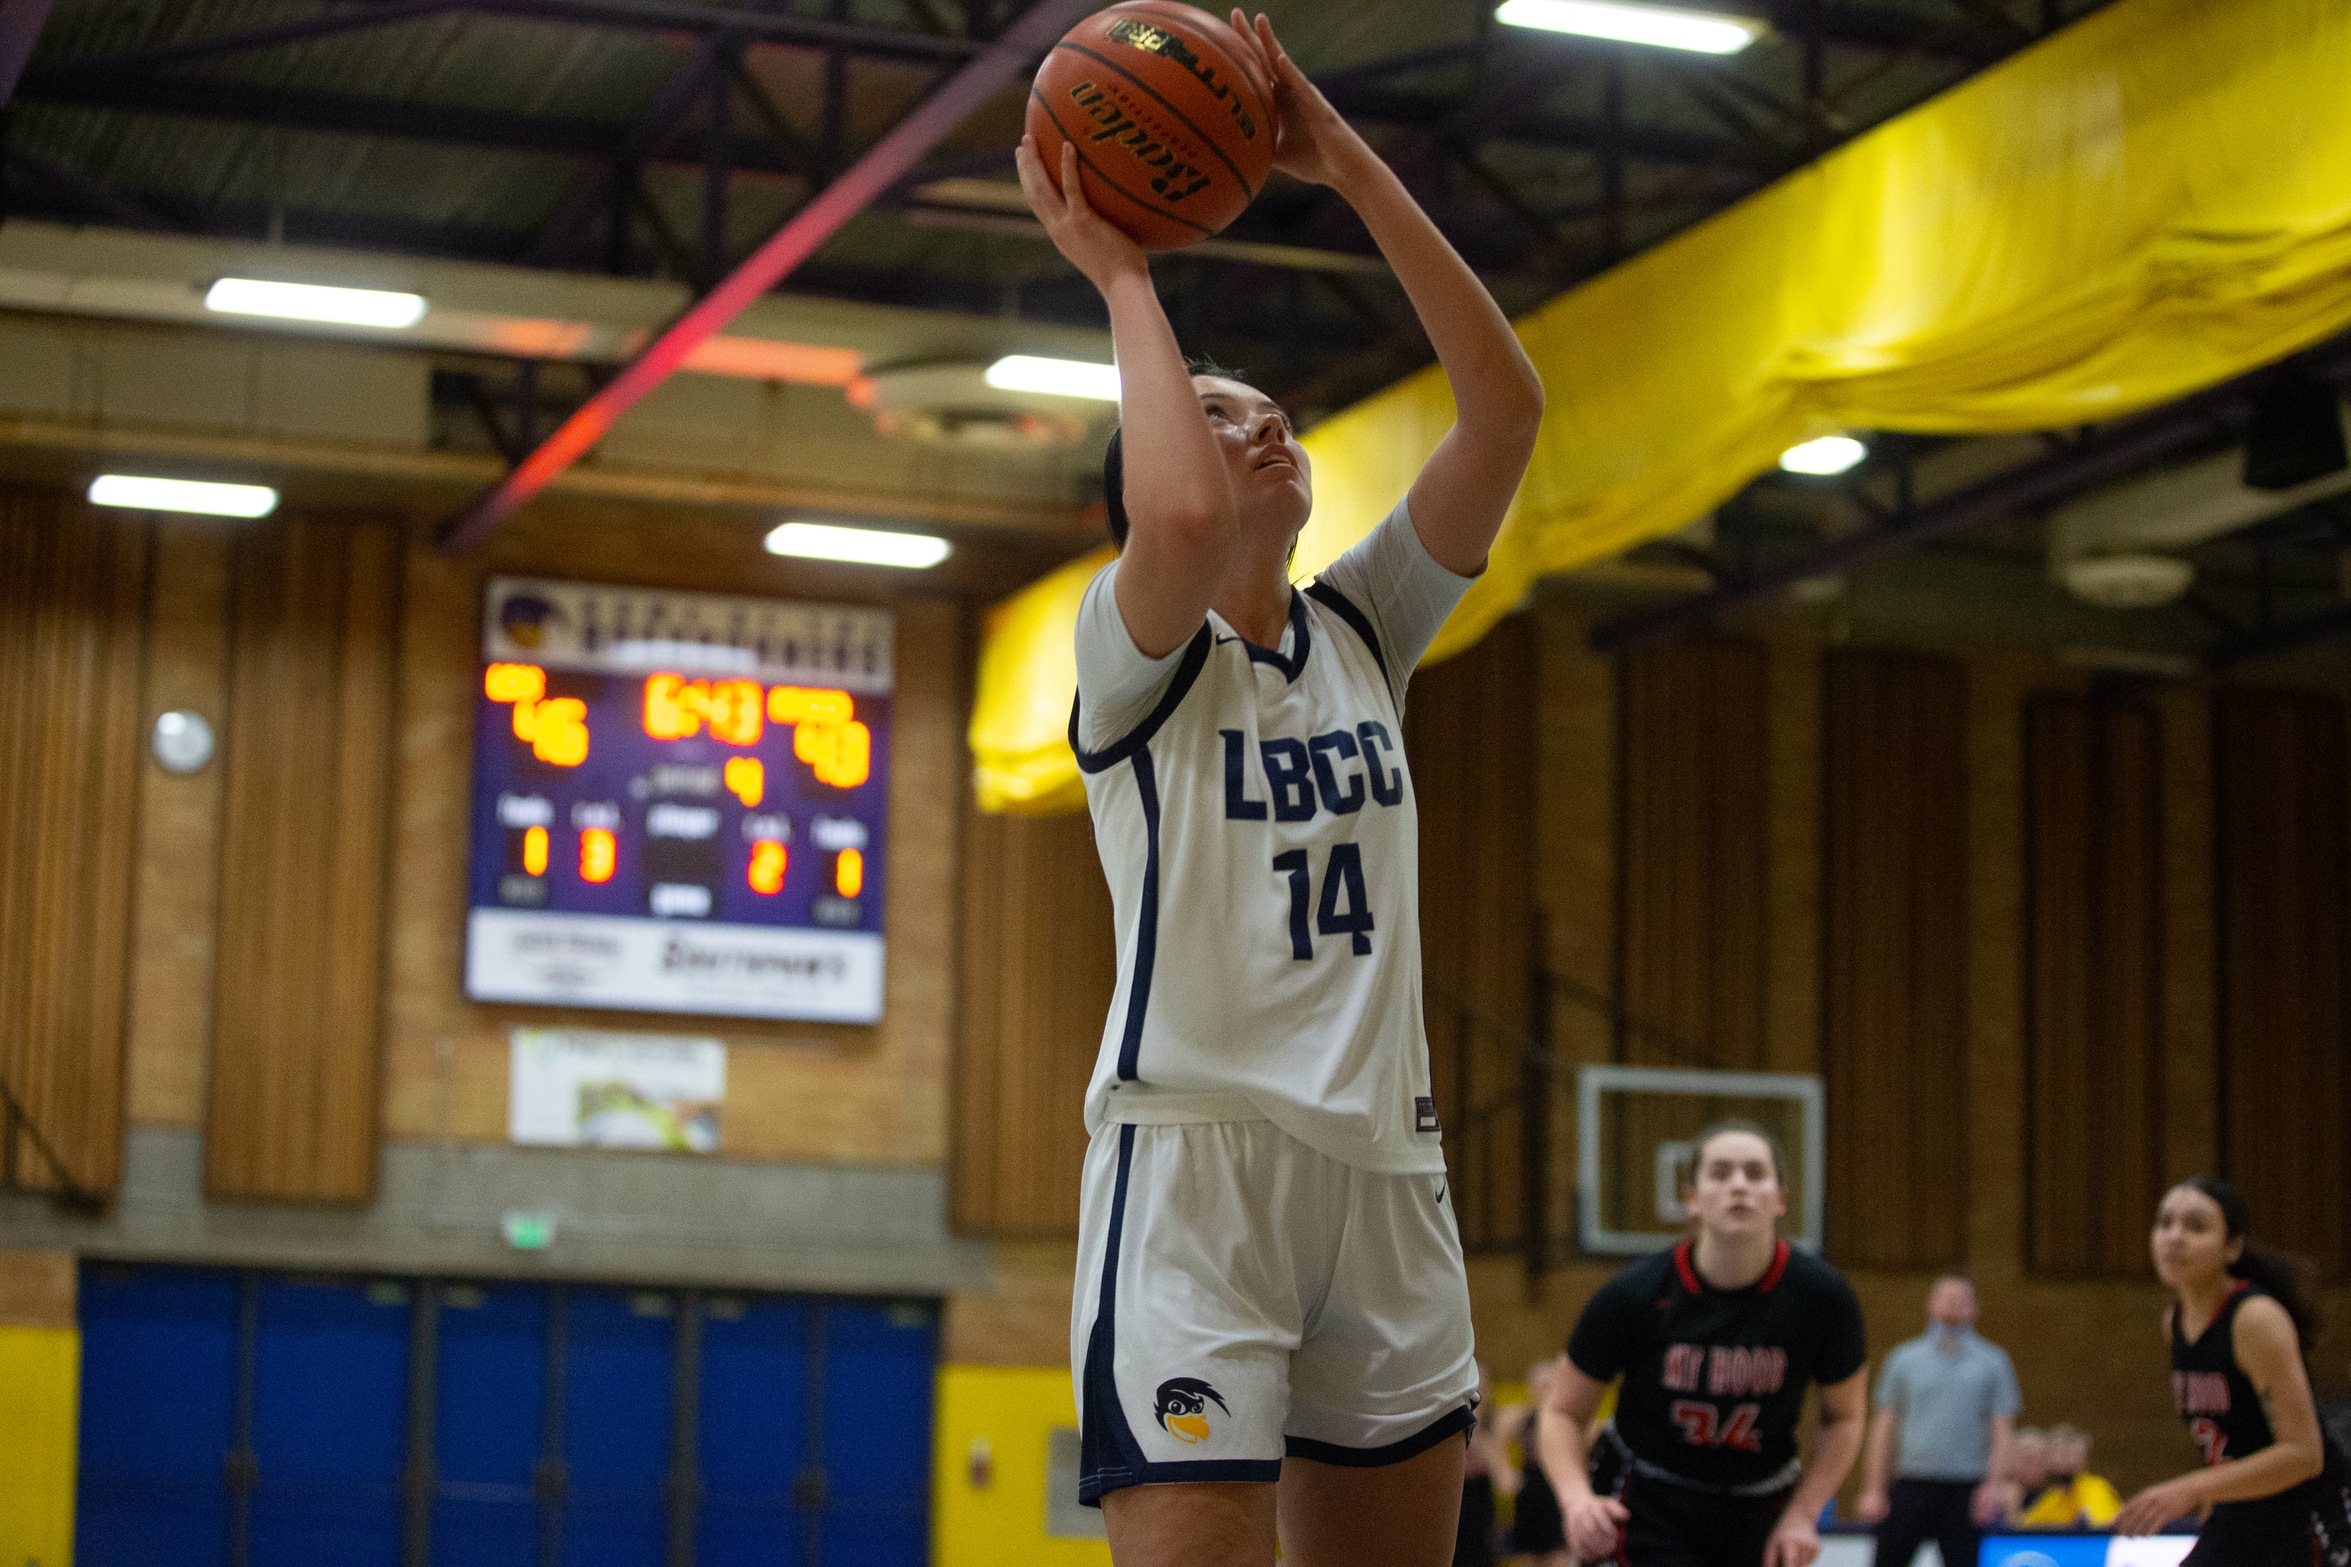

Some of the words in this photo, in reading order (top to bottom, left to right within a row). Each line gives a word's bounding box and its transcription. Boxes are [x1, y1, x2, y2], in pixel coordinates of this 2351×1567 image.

[1071, 81, 1211, 202] Baden
[1219, 720, 1403, 822] LBCC
[1273, 843, 1374, 960] 14
